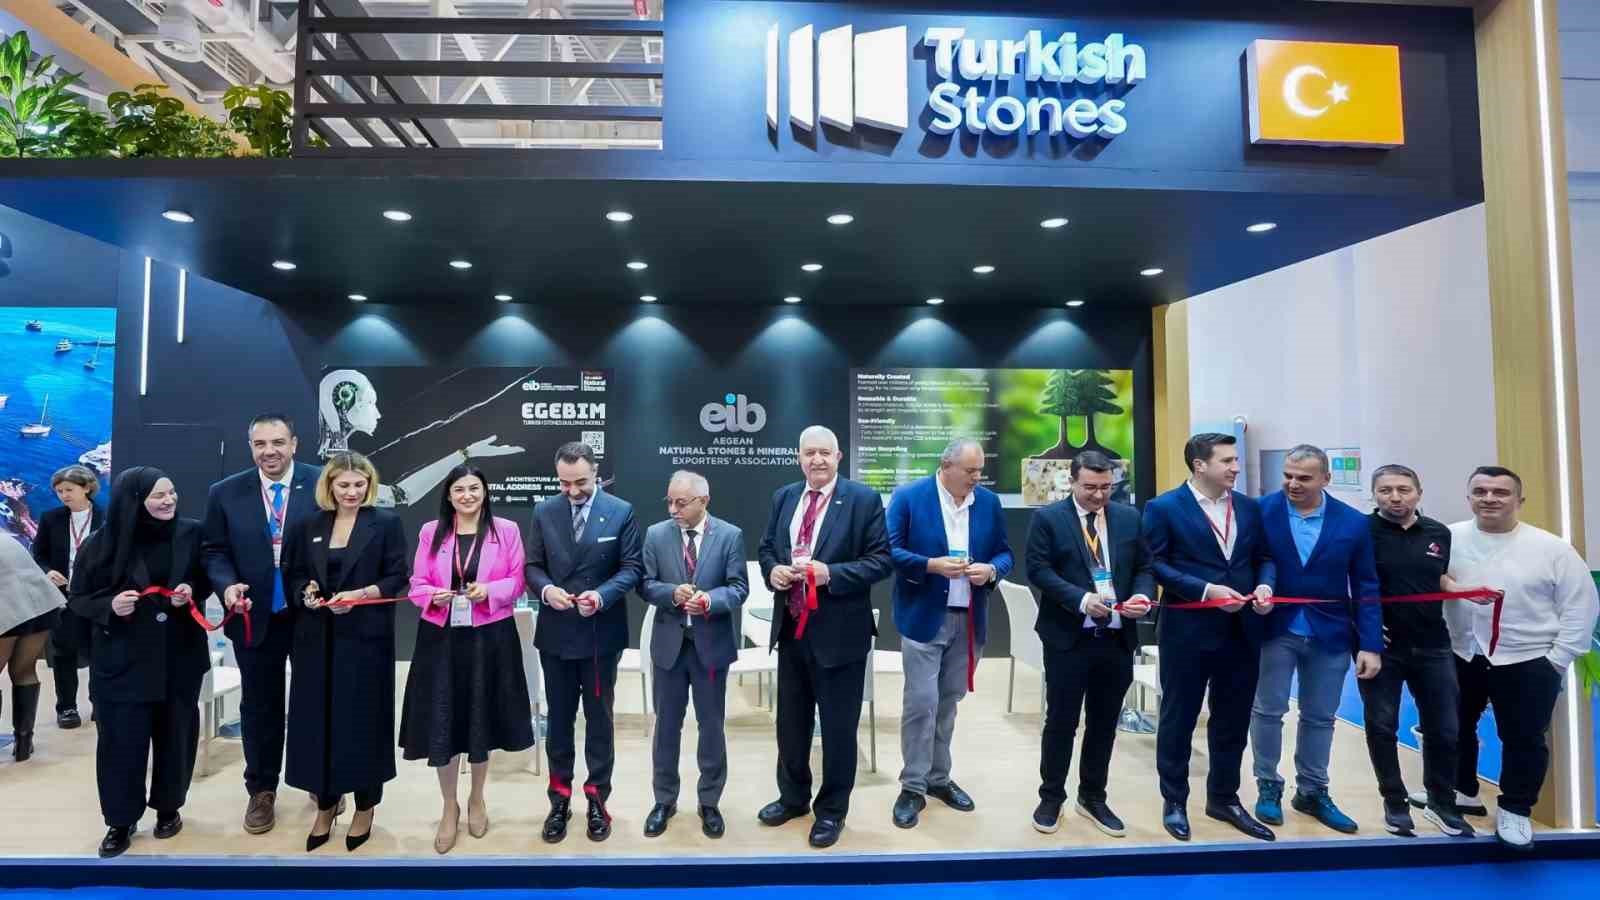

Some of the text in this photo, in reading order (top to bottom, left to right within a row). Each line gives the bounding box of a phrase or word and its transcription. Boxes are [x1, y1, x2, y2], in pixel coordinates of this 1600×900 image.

[923, 27, 1147, 84] Turkish
[928, 81, 1128, 140] Stones
[521, 402, 607, 420] EGEBIM
[699, 392, 767, 433] eib
[712, 437, 754, 446] AEGEAN
[659, 446, 706, 456] NATURAL
[706, 446, 746, 456] STONES
[748, 446, 755, 456] &
[672, 456, 799, 466] EXPORTERS' ASSOCIATION
